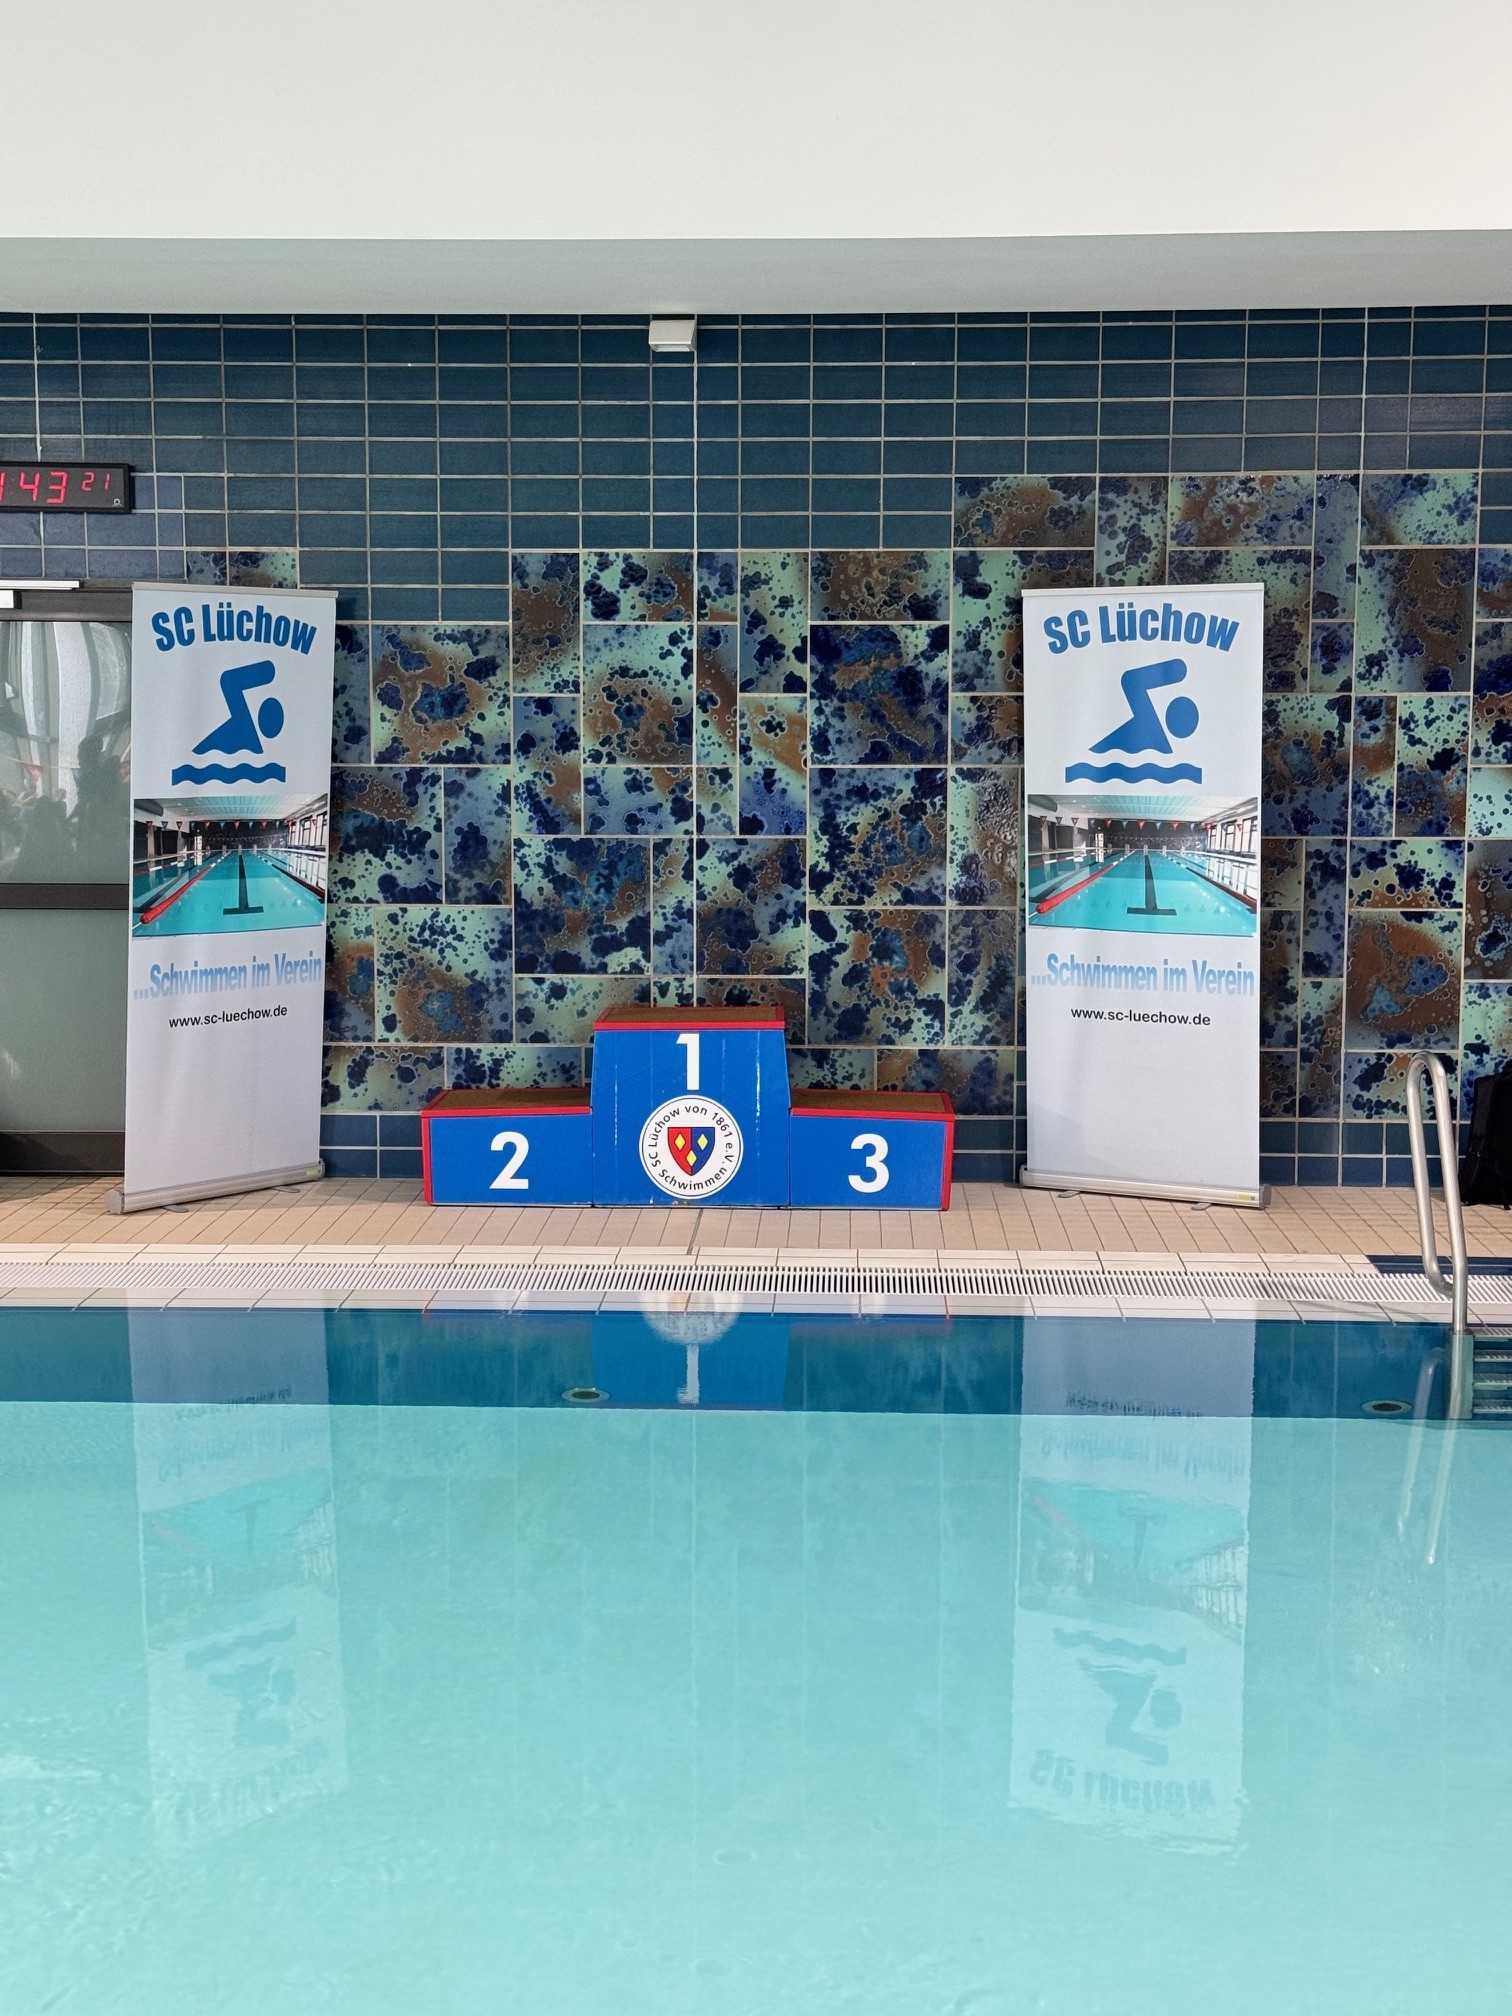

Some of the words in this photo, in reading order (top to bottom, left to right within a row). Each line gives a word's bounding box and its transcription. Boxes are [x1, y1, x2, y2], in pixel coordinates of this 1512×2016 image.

[151, 606, 195, 652] SC
[201, 602, 317, 655] Lüchow
[1043, 609, 1091, 654] SC
[1098, 602, 1240, 652] Lüchow
[252, 956, 270, 988] im
[274, 951, 322, 985] Verein
[1163, 959, 1187, 993] im
[1192, 959, 1255, 996] Verein
[168, 1005, 288, 1028] www.sc-luechow.de
[1070, 1008, 1211, 1026] www.sc-luechow.de
[676, 1033, 700, 1091] 1
[648, 1107, 681, 1148] Lüchow
[684, 1105, 708, 1116] von
[711, 1112, 733, 1138] 1861
[489, 1131, 530, 1190] 2
[648, 1151, 661, 1168] SC
[847, 1134, 890, 1193] 3
[658, 1168, 728, 1191] Schwimmen
